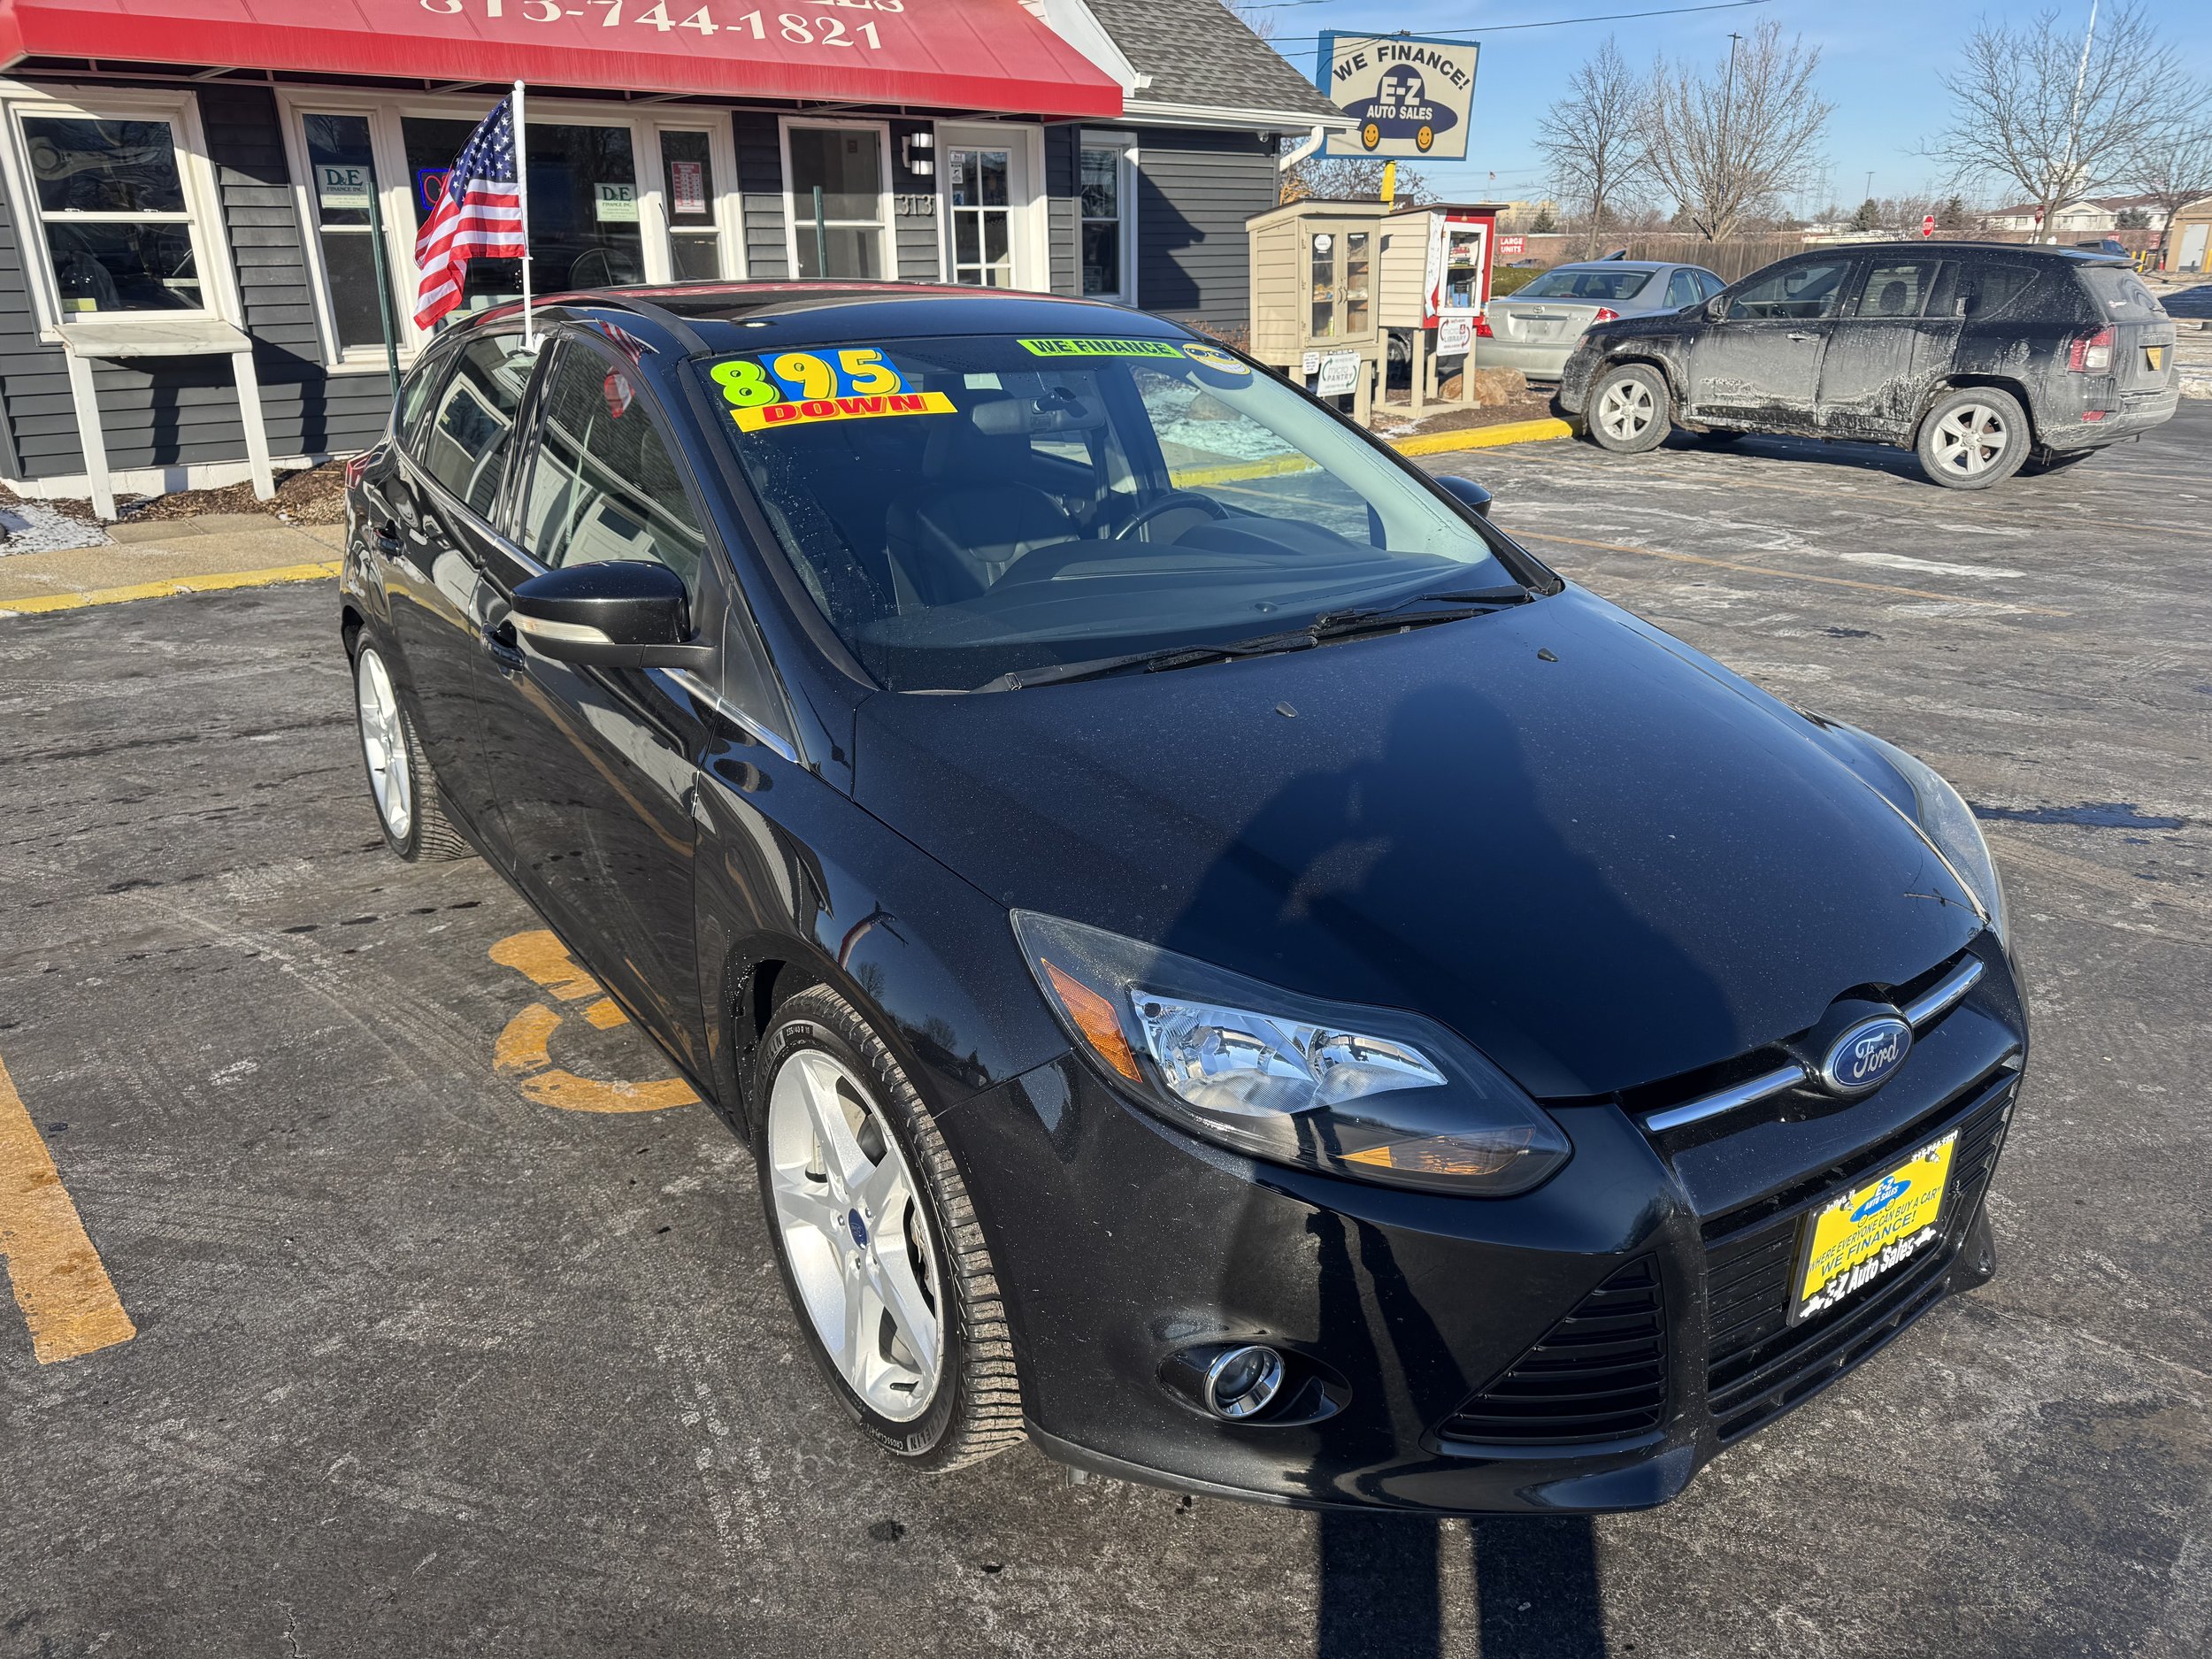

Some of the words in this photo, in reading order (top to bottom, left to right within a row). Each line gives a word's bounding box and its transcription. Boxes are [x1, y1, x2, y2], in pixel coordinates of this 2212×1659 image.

[1333, 52, 1369, 81] WE
[1377, 45, 1471, 90] FINANCE!
[1379, 76, 1422, 106] E-Z
[1366, 105, 1396, 119] AUTO
[1399, 106, 1433, 120] SALES
[324, 168, 363, 187] D&E
[899, 195, 933, 215] 313
[1029, 340, 1071, 354] WE
[1077, 341, 1171, 355] FINANCE
[710, 349, 901, 407] 895
[1327, 373, 1353, 382] PANTRY
[762, 394, 928, 424] DOWN
[1853, 1032, 1900, 1079] Ford
[1864, 1196, 1880, 1211] AUTO
[1880, 1185, 1900, 1202] SALES
[1875, 1178, 1894, 1197] E-Z
[1836, 1219, 1878, 1254] EVERYONE
[1878, 1209, 1895, 1227] CAN
[1895, 1199, 1914, 1218] BUY
[1912, 1196, 1919, 1209] A
[1821, 1252, 1844, 1277] WE
[1847, 1210, 1916, 1261] FINANCE!
[1847, 1256, 1879, 1294] Auto
[1880, 1237, 1916, 1273] Sales
